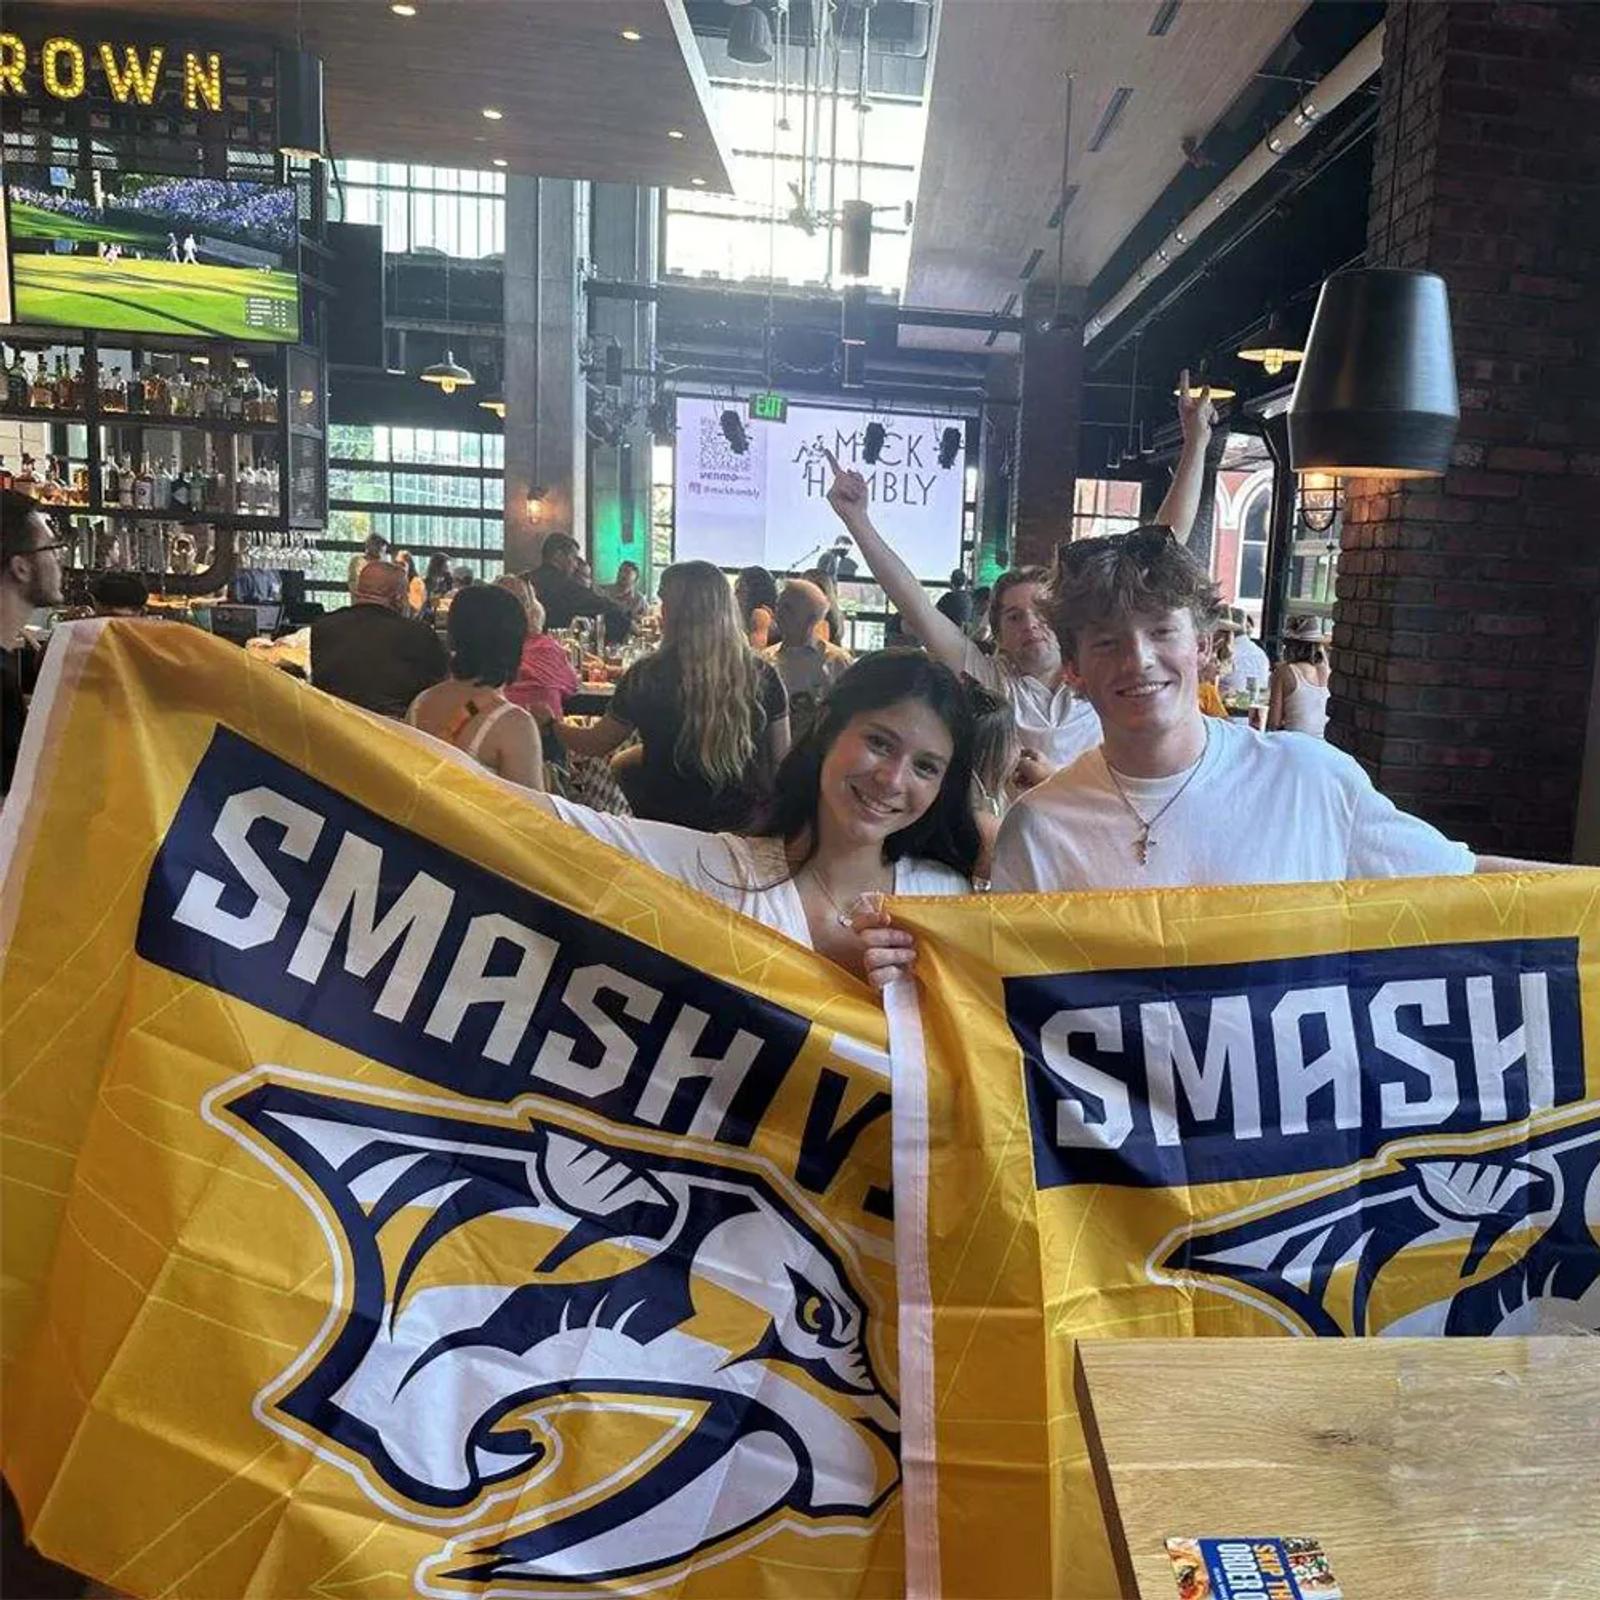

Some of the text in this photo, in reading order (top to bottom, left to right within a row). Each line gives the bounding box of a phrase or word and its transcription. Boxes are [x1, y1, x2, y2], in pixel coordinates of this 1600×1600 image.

[0, 33, 223, 112] ROWN
[755, 394, 781, 419] EXIT
[835, 429, 923, 468] MCK
[172, 785, 764, 1143] SMASH
[1039, 972, 1555, 1150] SMASH
[1216, 1543, 1266, 1591] ORDER
[1252, 1544, 1285, 1577] SKIP
